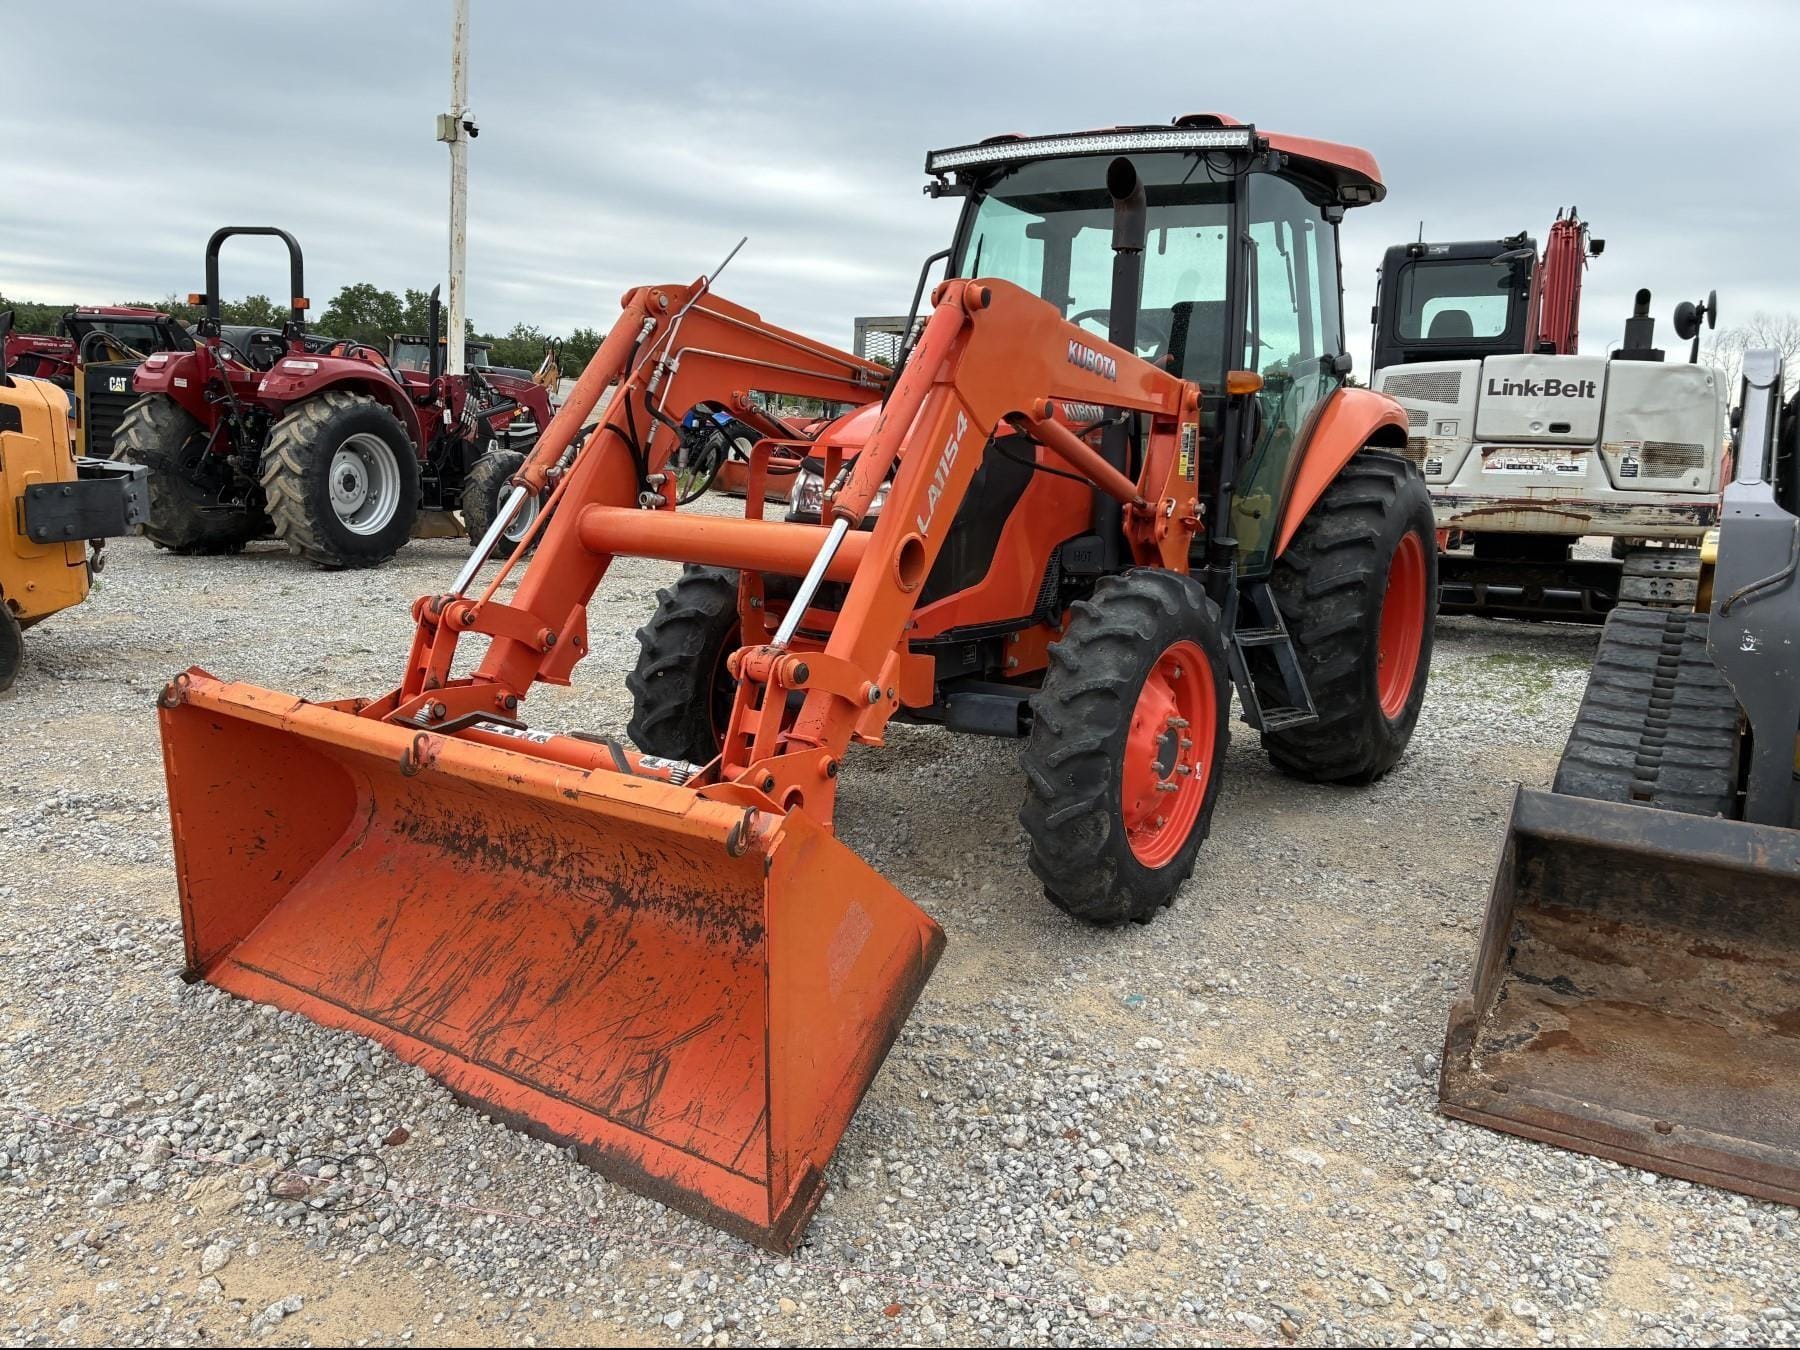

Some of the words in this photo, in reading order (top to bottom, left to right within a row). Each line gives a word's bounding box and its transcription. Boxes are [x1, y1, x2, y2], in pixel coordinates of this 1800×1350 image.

[1067, 338, 1117, 380] KUBOTA
[108, 376, 128, 392] CAT
[1487, 378, 1597, 398] Link-Belt
[916, 409, 968, 535] LA1154
